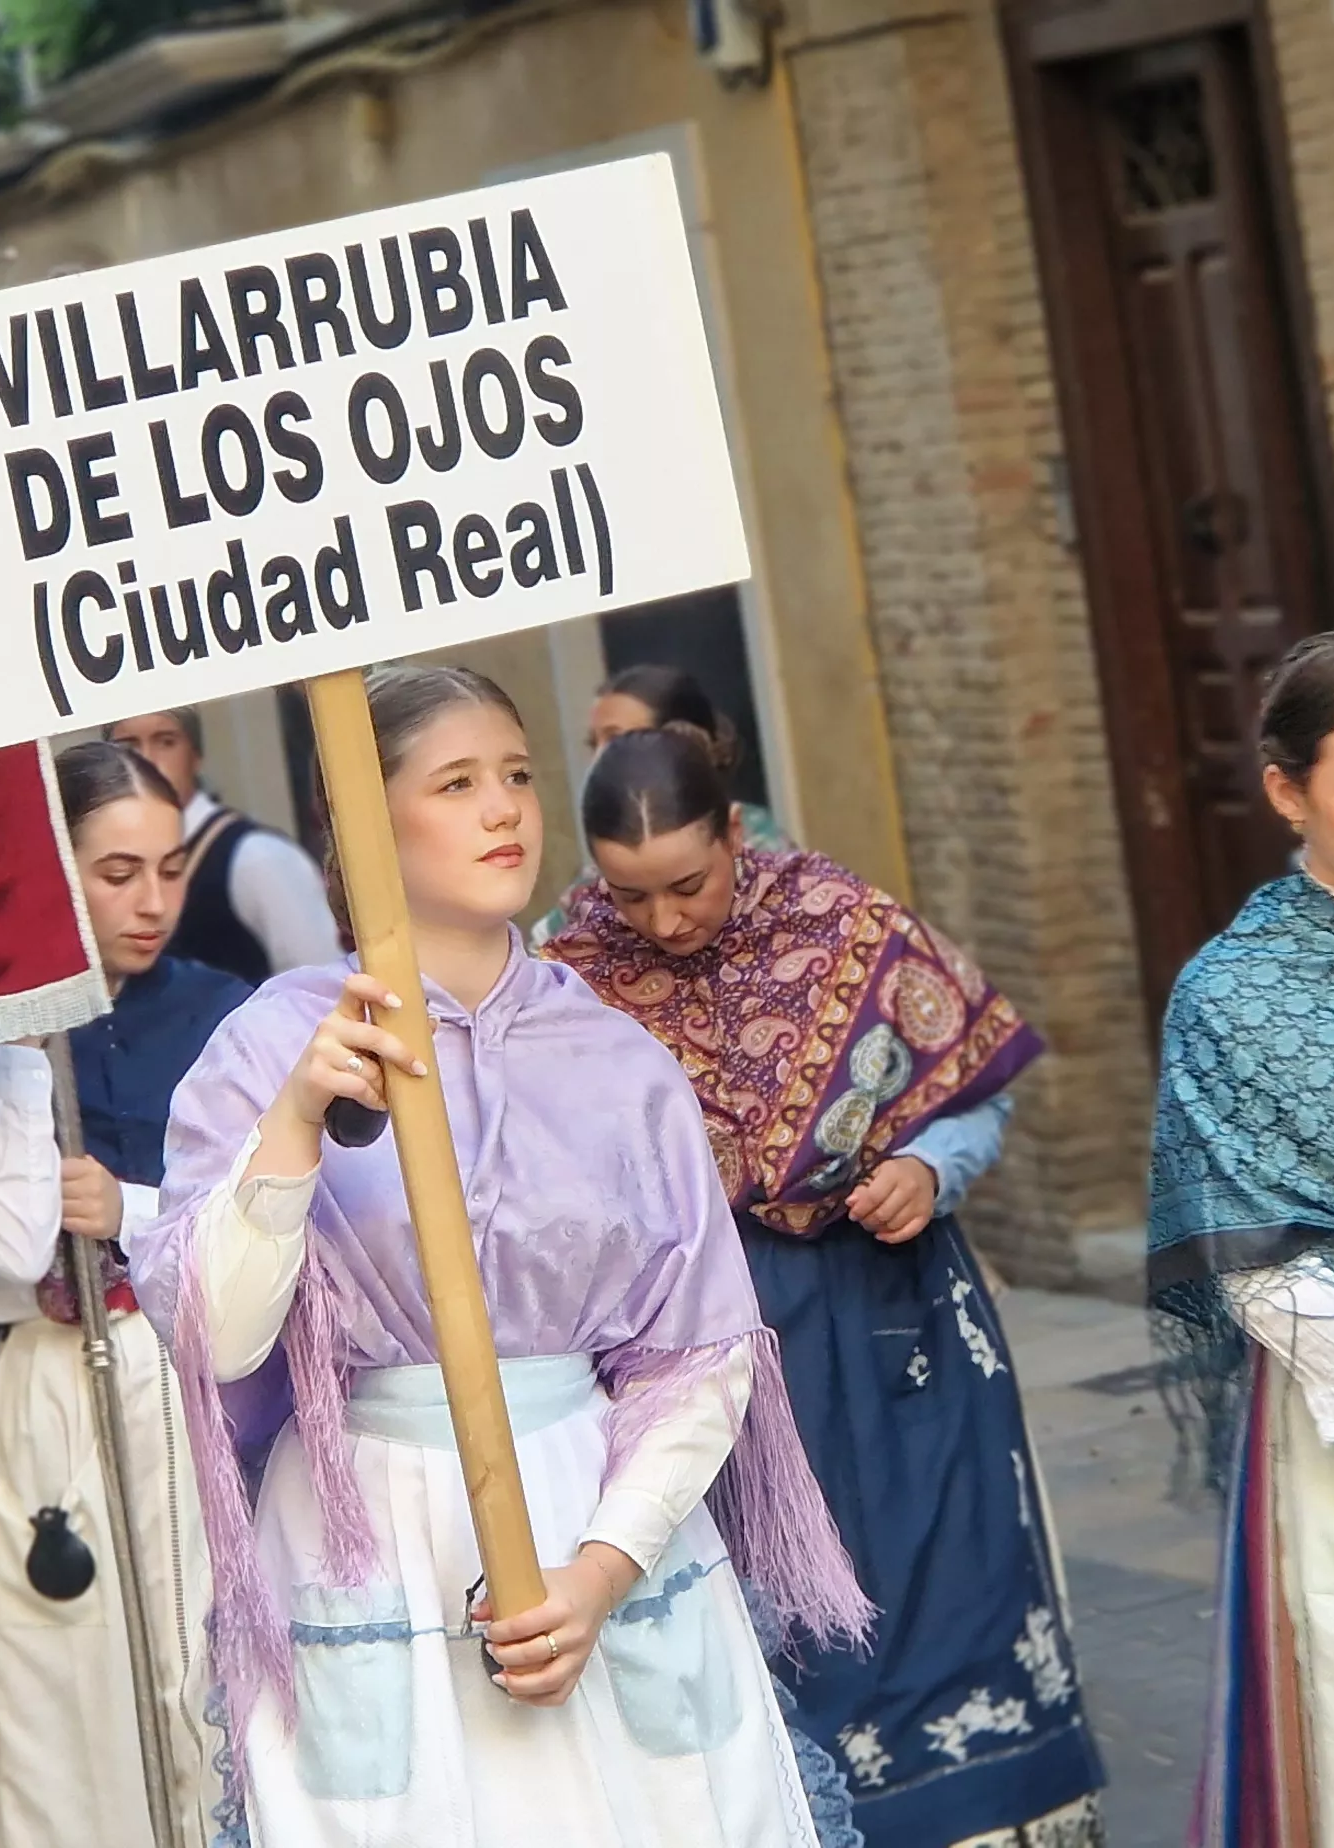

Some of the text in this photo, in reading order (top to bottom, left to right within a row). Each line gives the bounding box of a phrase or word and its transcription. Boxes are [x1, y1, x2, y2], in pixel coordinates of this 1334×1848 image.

[5, 335, 583, 560] DE LOS OJOS
[33, 463, 613, 717] (Ciudad Real)
